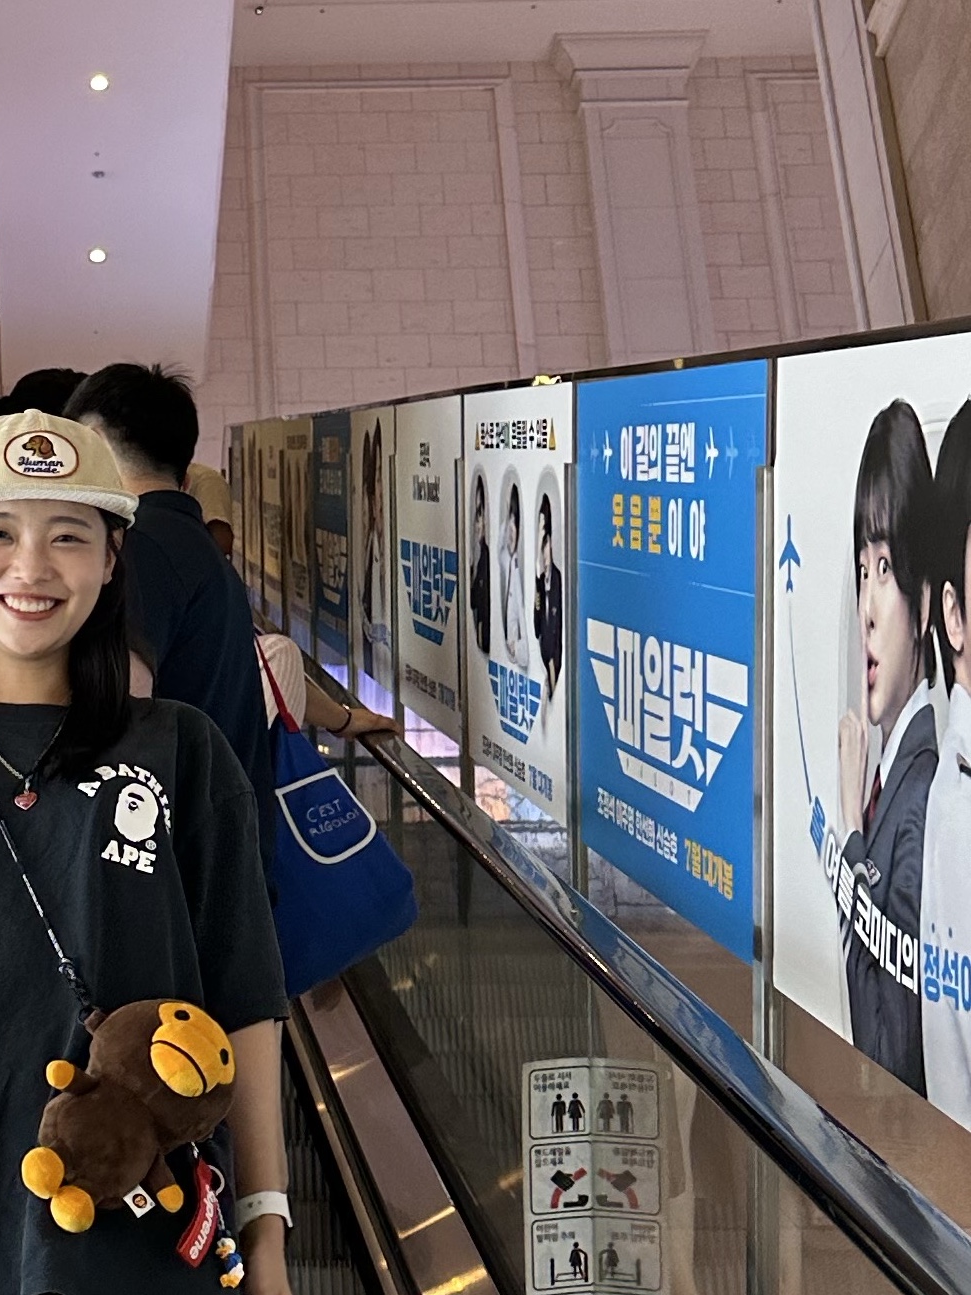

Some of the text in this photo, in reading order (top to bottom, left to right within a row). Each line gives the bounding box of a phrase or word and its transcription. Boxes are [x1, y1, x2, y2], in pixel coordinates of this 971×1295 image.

[17, 456, 64, 467] Human
[620, 422, 695, 483] 이 길의 끝엔
[617, 626, 705, 781] 파일럿
[101, 840, 156, 874] APE
[684, 838, 701, 880] 7월
[703, 846, 733, 900] 대개봉
[824, 833, 856, 920] 여름
[855, 884, 919, 995] 코미디의
[189, 1184, 218, 1260] upreme
